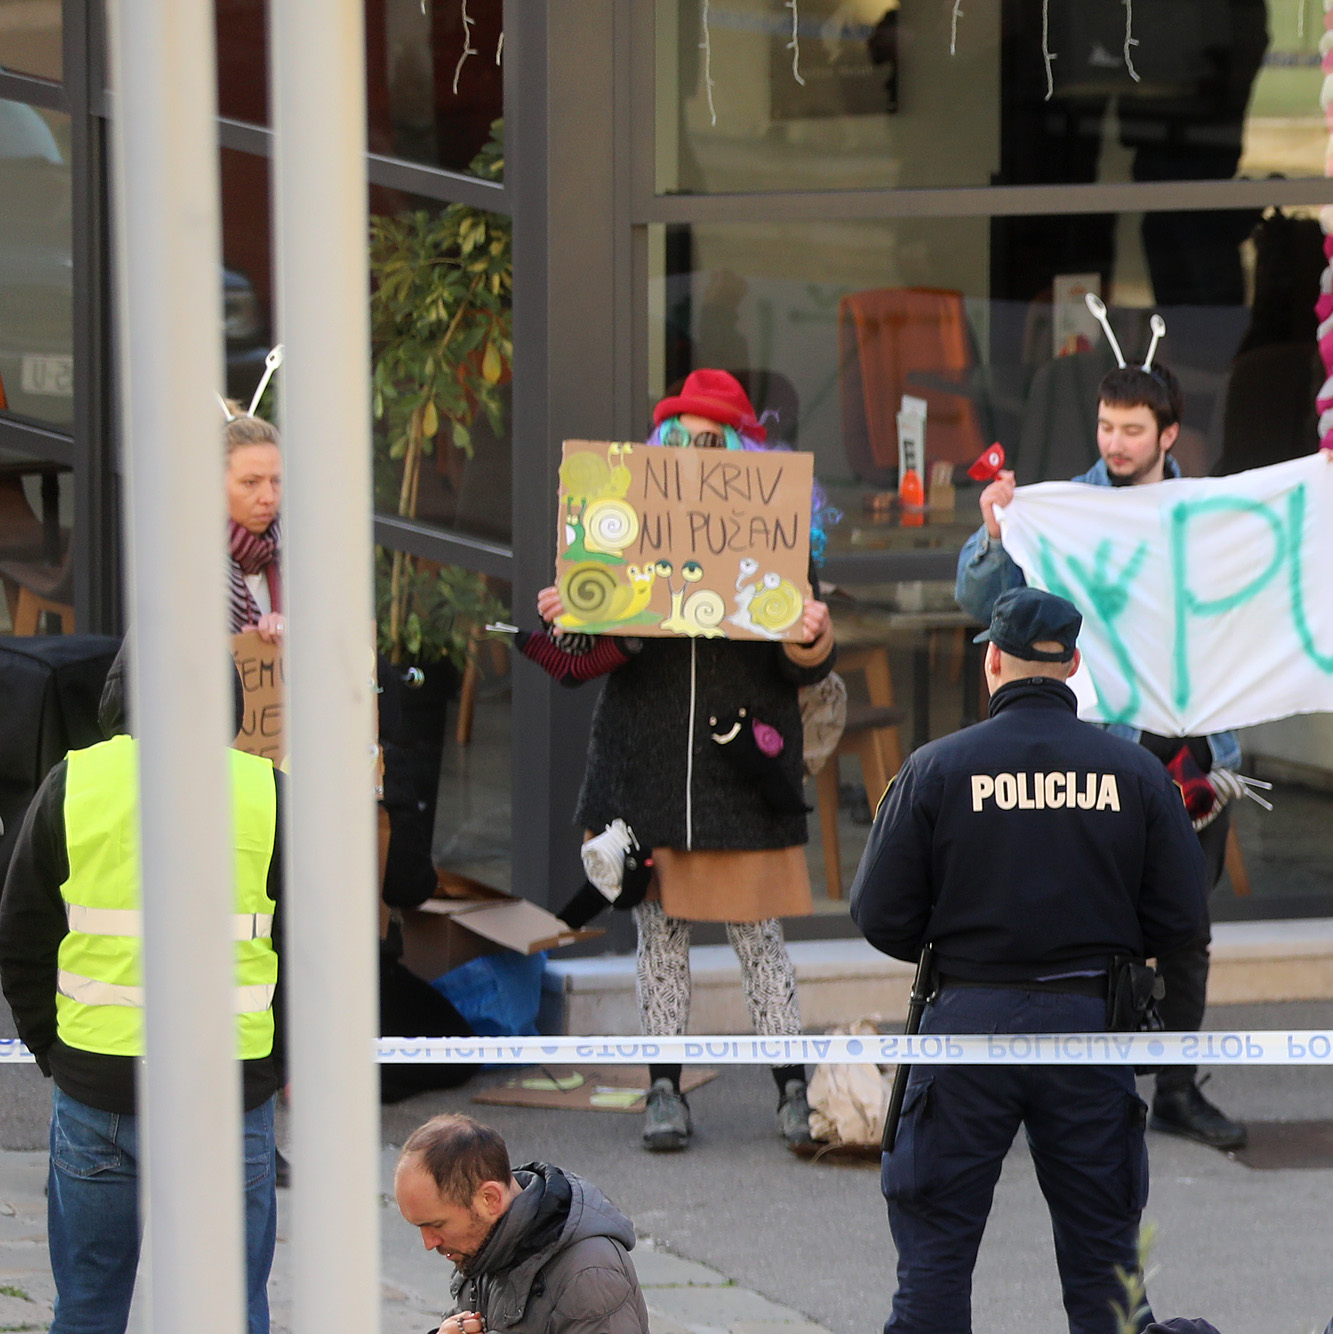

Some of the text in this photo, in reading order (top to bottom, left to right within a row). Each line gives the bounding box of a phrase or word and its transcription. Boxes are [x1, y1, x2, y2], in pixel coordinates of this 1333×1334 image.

[644, 457, 784, 505] NI KRIV
[640, 508, 798, 555] NI PUŽAN
[971, 771, 1121, 812] POLICIJA
